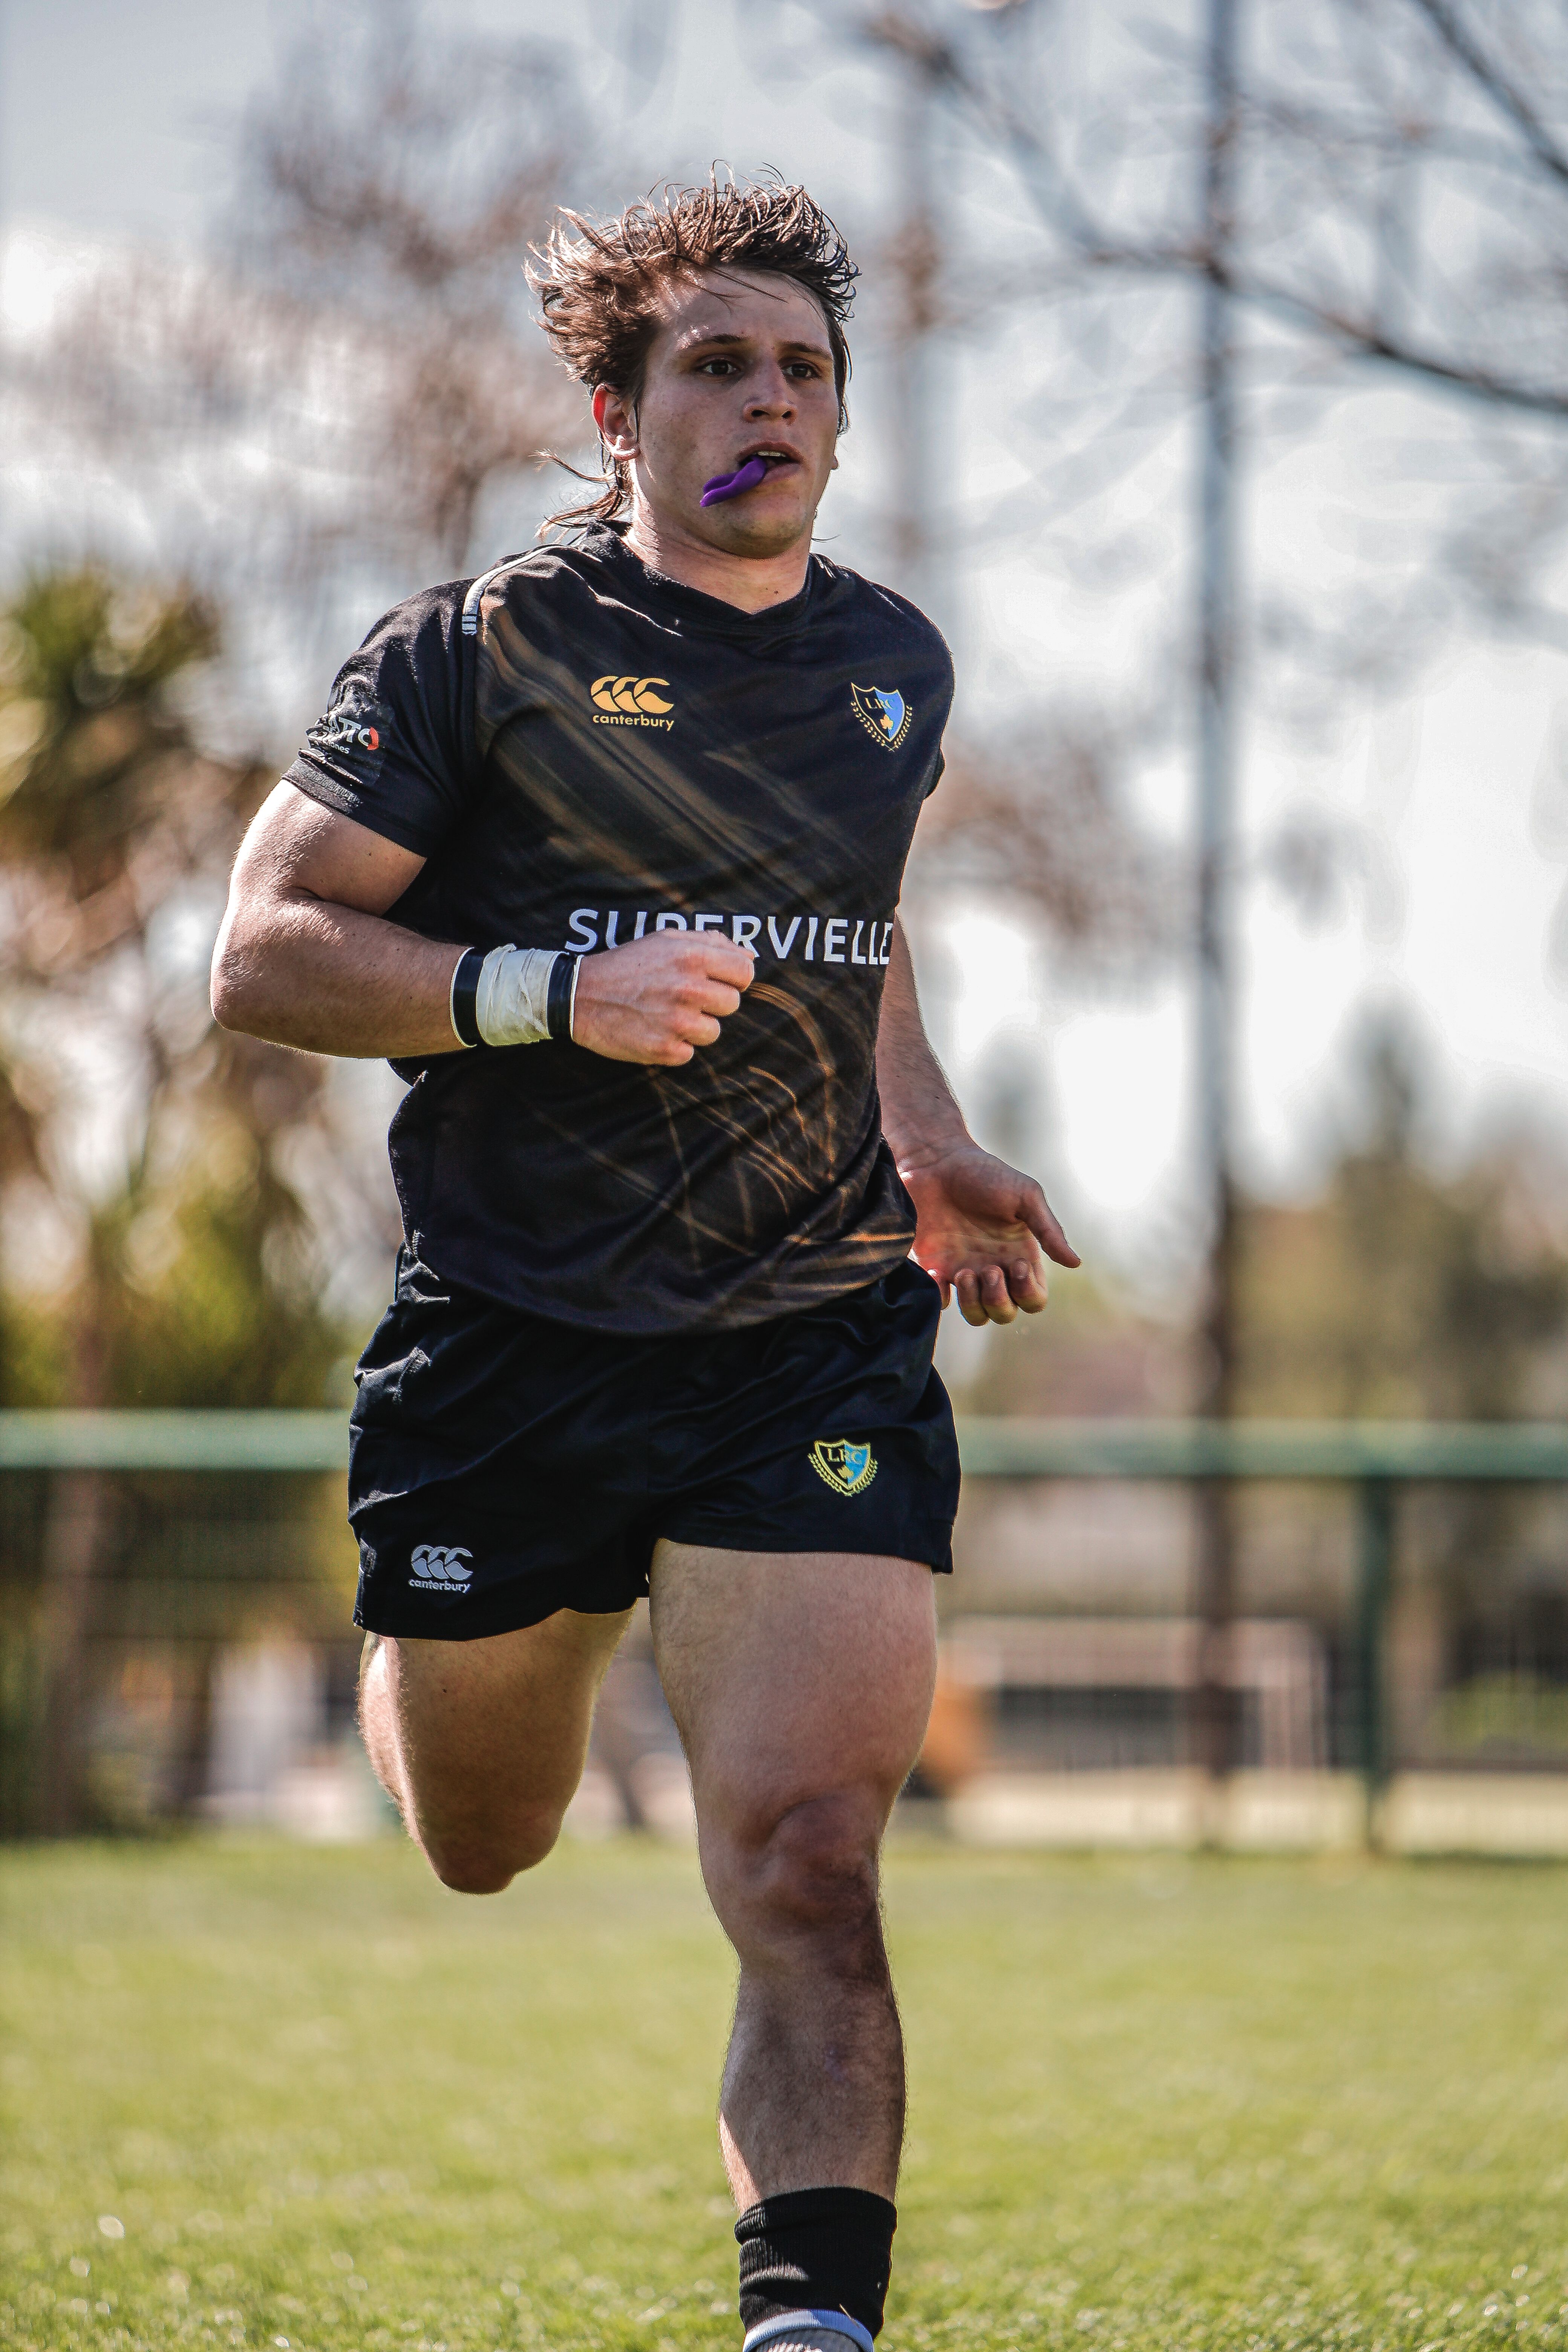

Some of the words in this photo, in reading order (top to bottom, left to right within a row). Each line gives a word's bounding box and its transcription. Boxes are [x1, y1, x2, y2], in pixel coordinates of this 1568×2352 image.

[593, 715, 674, 731] canterbury
[827, 1448, 862, 1464] LRC
[409, 1579, 471, 1594] canterbury
